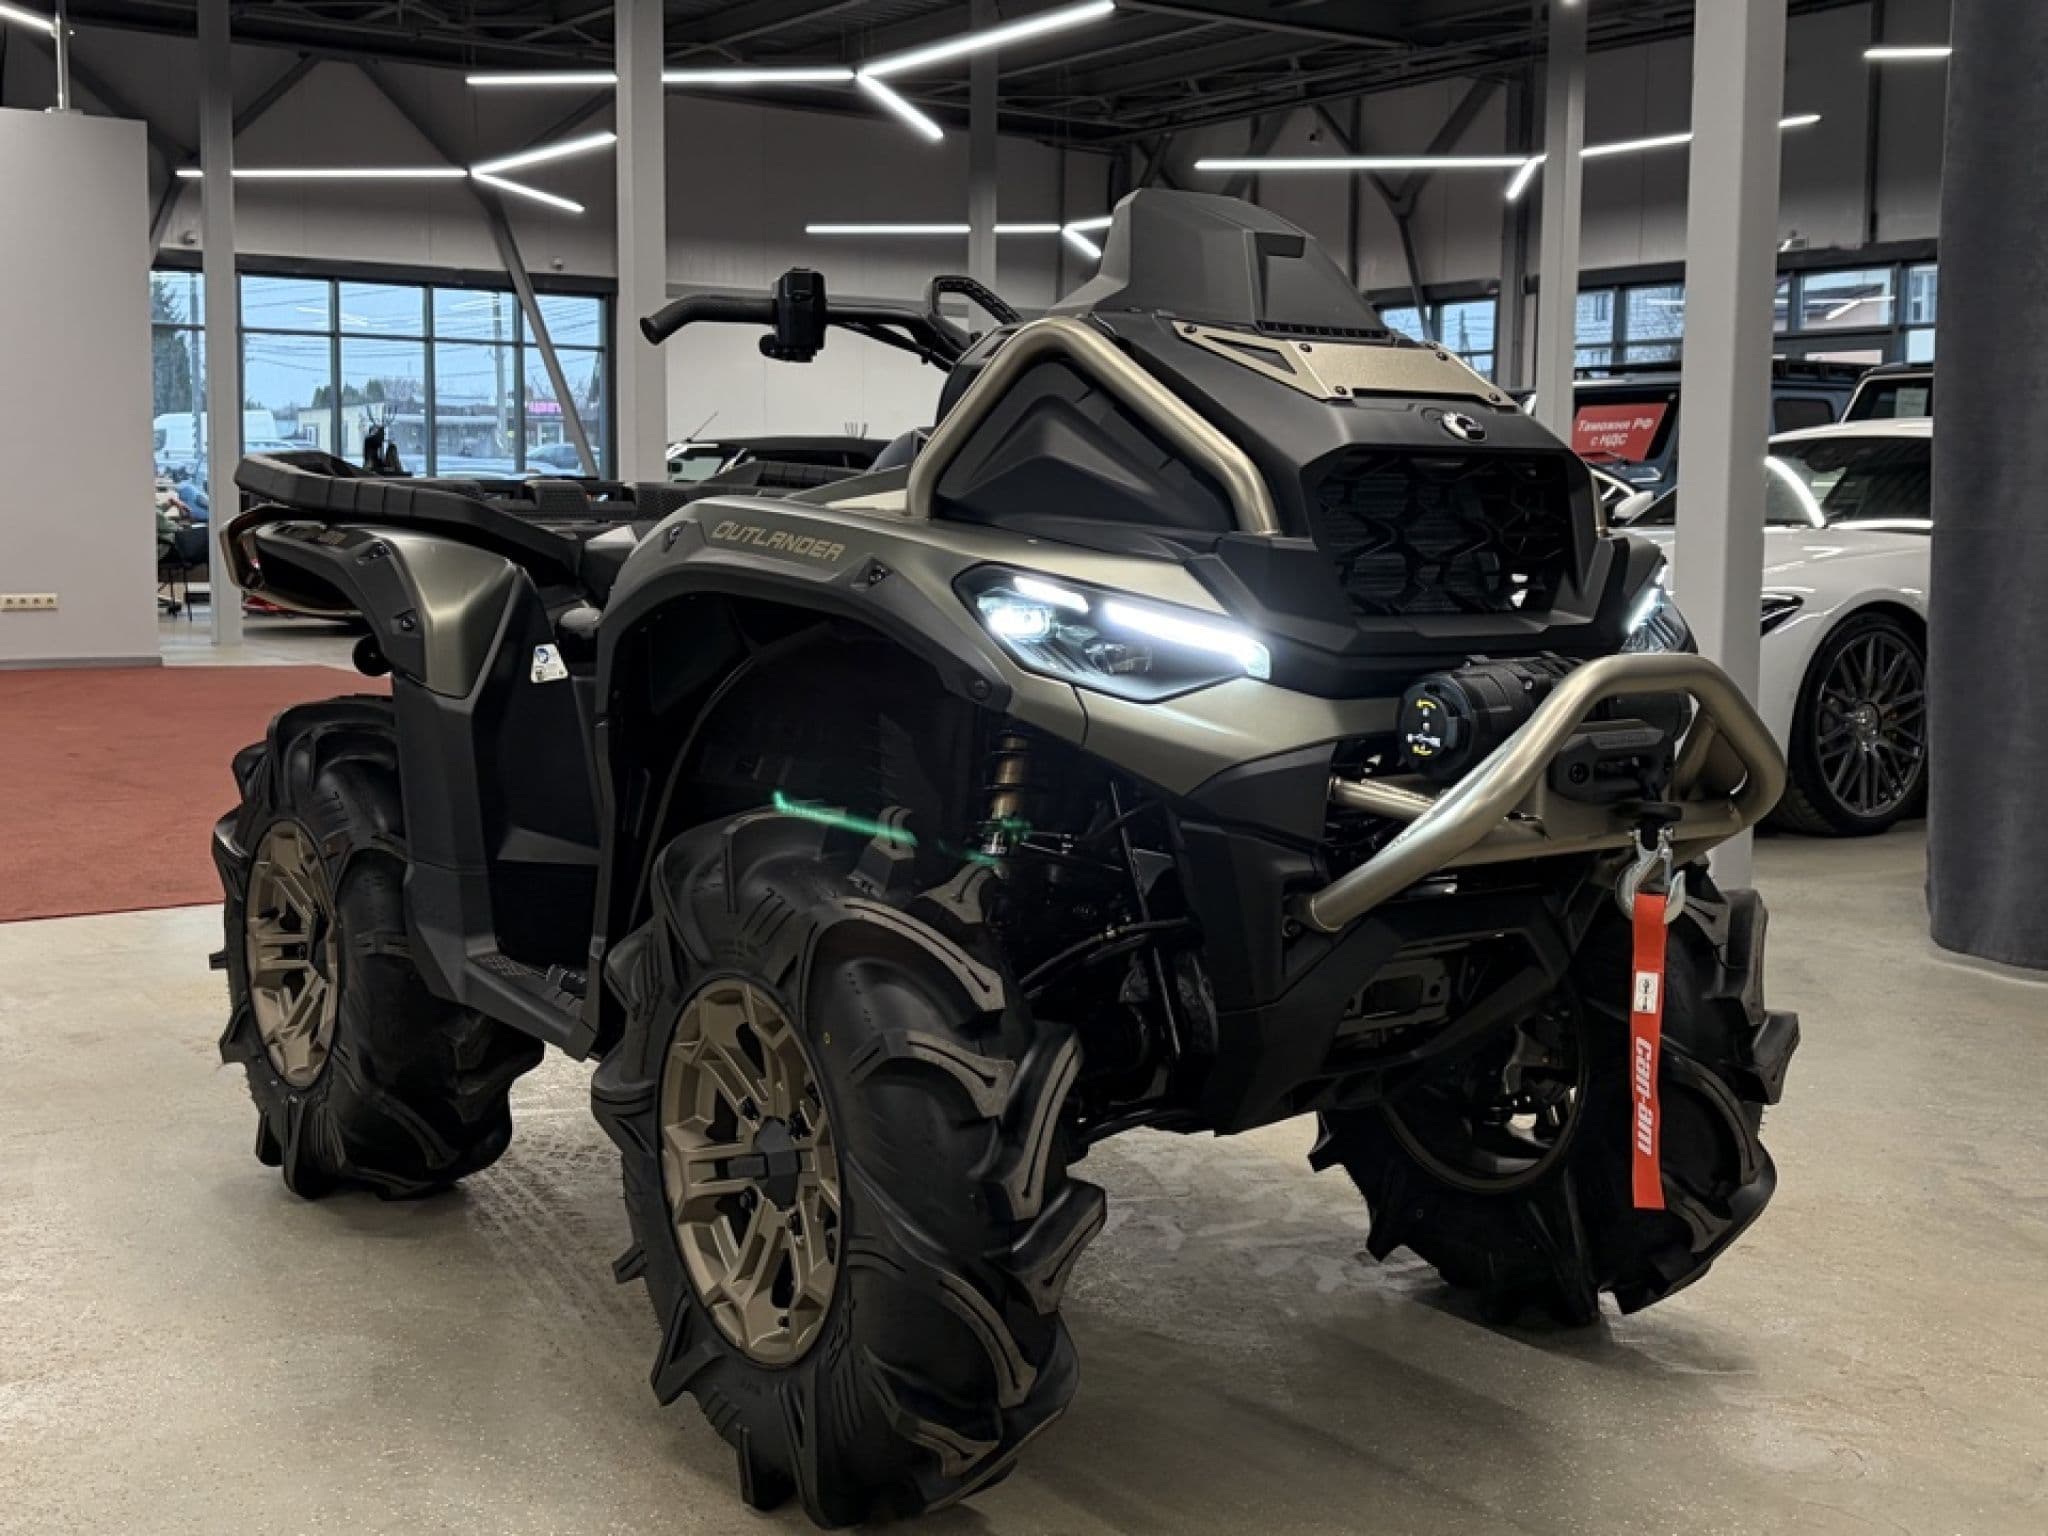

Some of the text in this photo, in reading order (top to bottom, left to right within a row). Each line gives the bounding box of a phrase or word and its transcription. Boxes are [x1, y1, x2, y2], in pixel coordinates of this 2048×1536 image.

[1632, 418, 1654, 429] РФ
[1600, 433, 1628, 447] НДС
[712, 521, 844, 560] OUTLANDER
